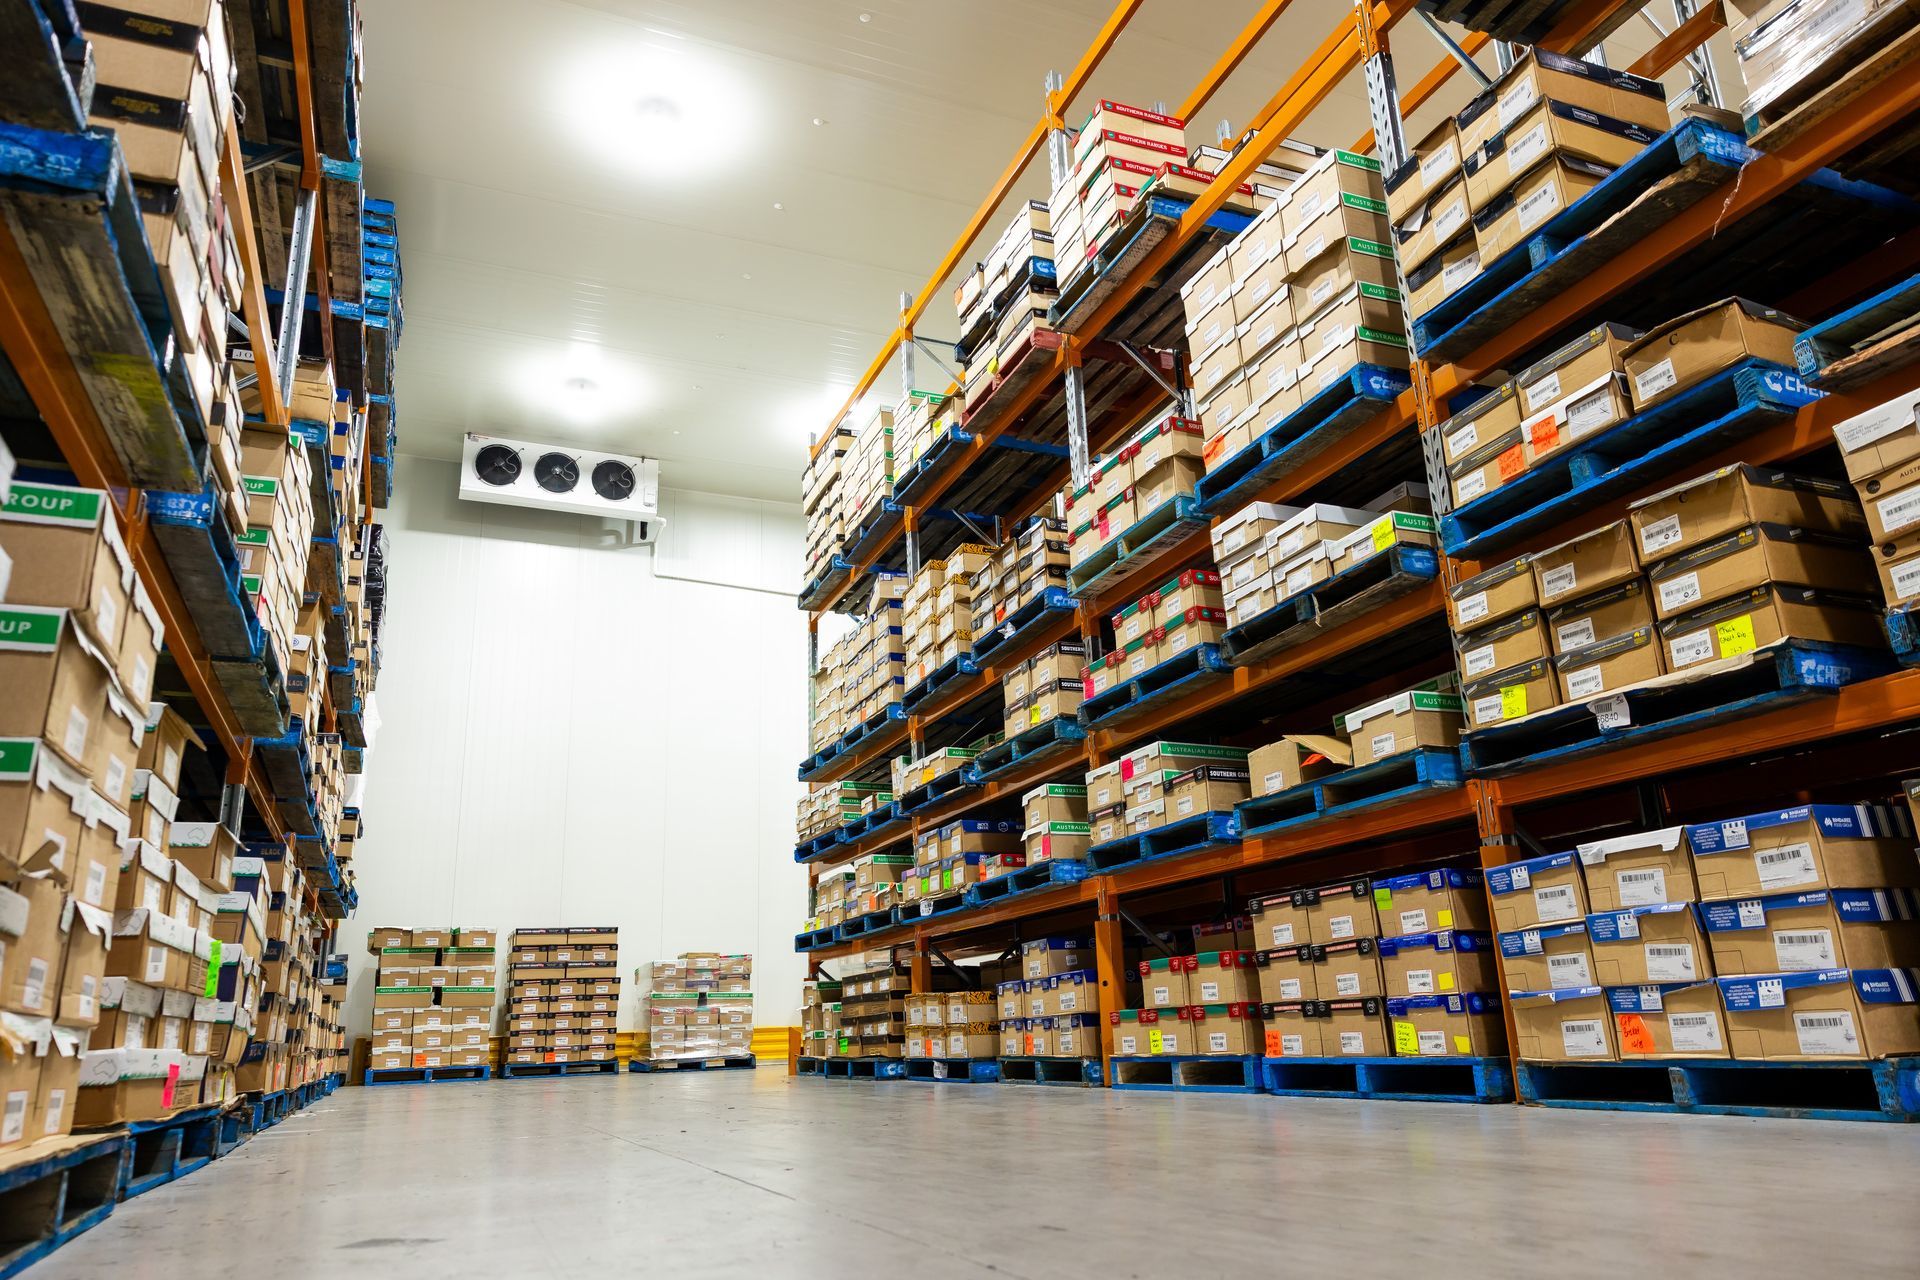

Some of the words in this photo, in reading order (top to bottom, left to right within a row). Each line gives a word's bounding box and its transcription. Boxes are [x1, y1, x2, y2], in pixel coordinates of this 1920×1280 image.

[1116, 105, 1144, 117] SOUTHERN
[1144, 112, 1164, 122] RANGES
[1118, 134, 1146, 146] SOUTHERN
[1146, 141, 1168, 150] RANGES
[1126, 162, 1153, 174] SOUTHERN
[1182, 168, 1211, 182] SOUTHERN
[1669, 334, 1680, 346] C
[1168, 746, 1206, 756] AUSTRALIAN
[1210, 770, 1237, 778] SOUTHERN
